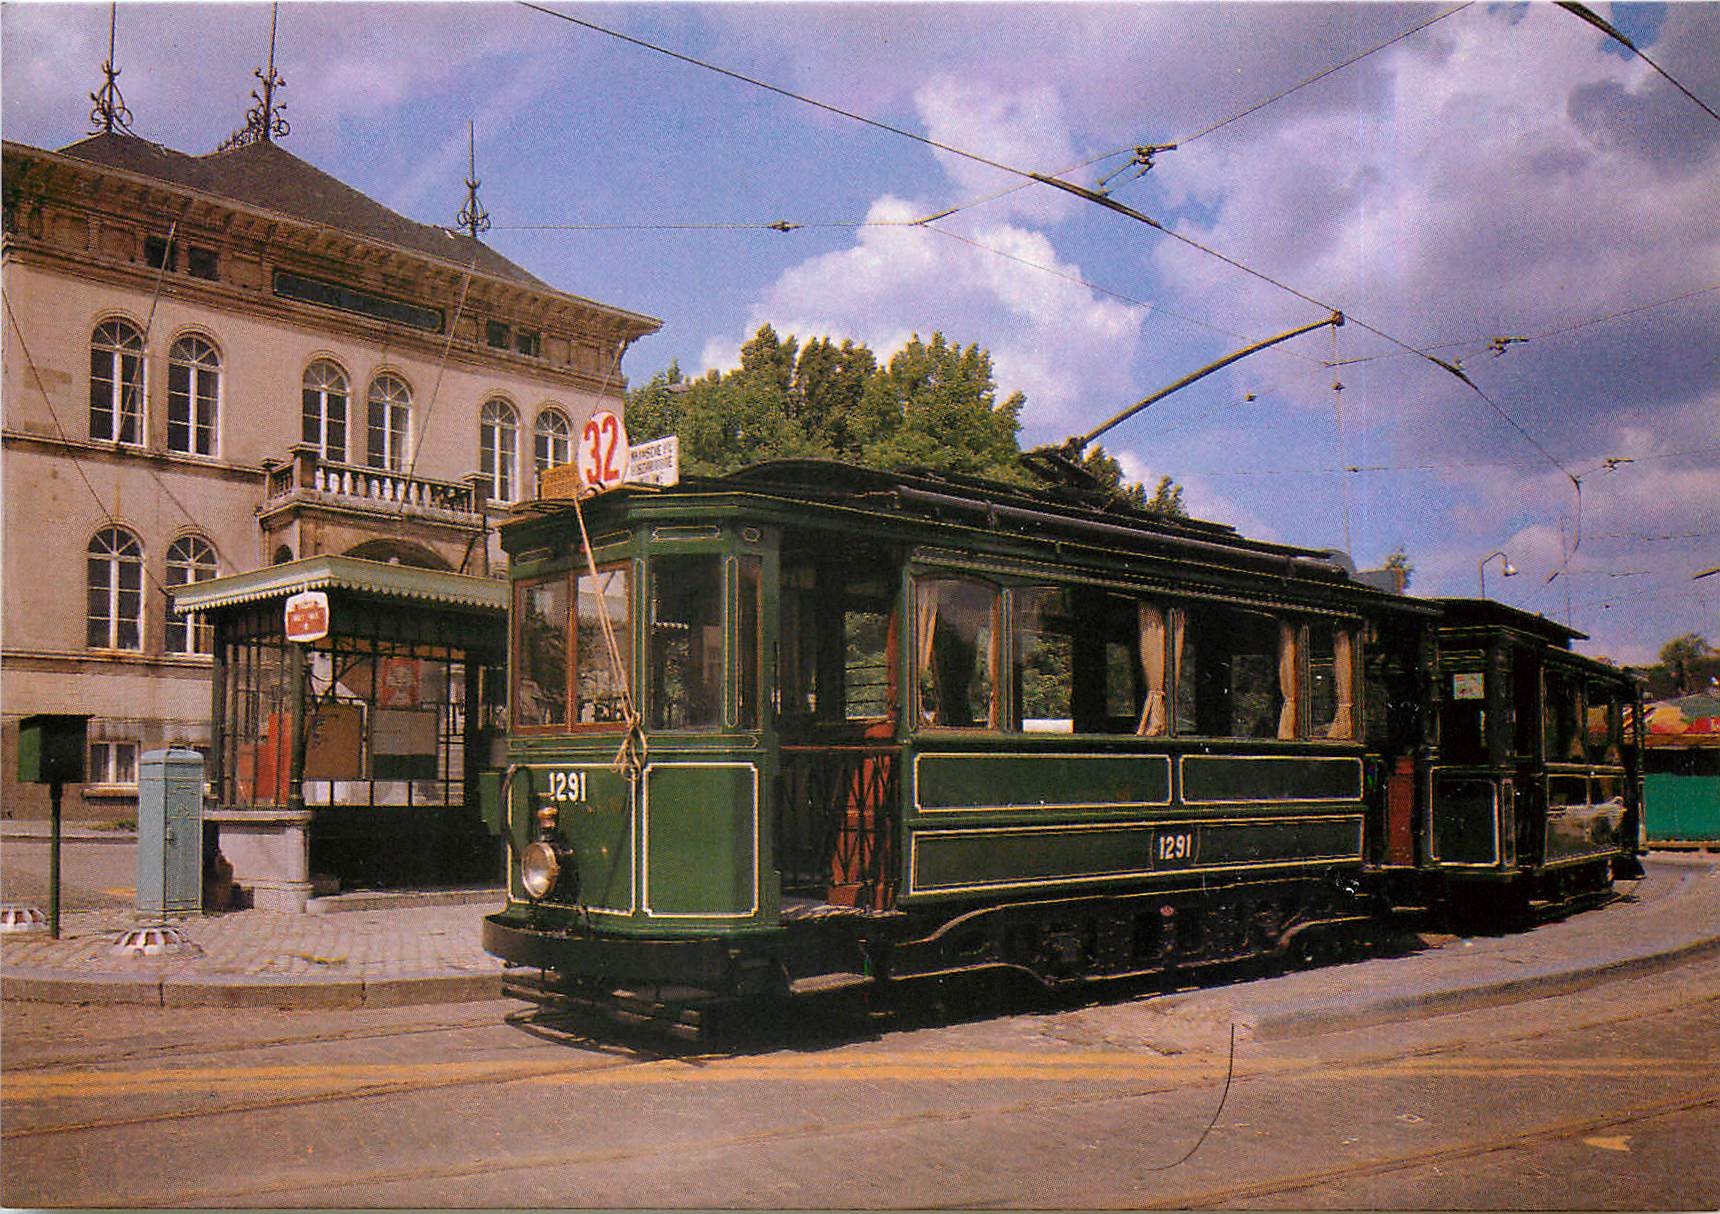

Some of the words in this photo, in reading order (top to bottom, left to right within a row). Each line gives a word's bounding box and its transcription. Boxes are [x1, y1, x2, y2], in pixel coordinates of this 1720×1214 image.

[584, 415, 620, 485] 32
[549, 771, 587, 802] 1291
[1159, 832, 1193, 860] 1291
